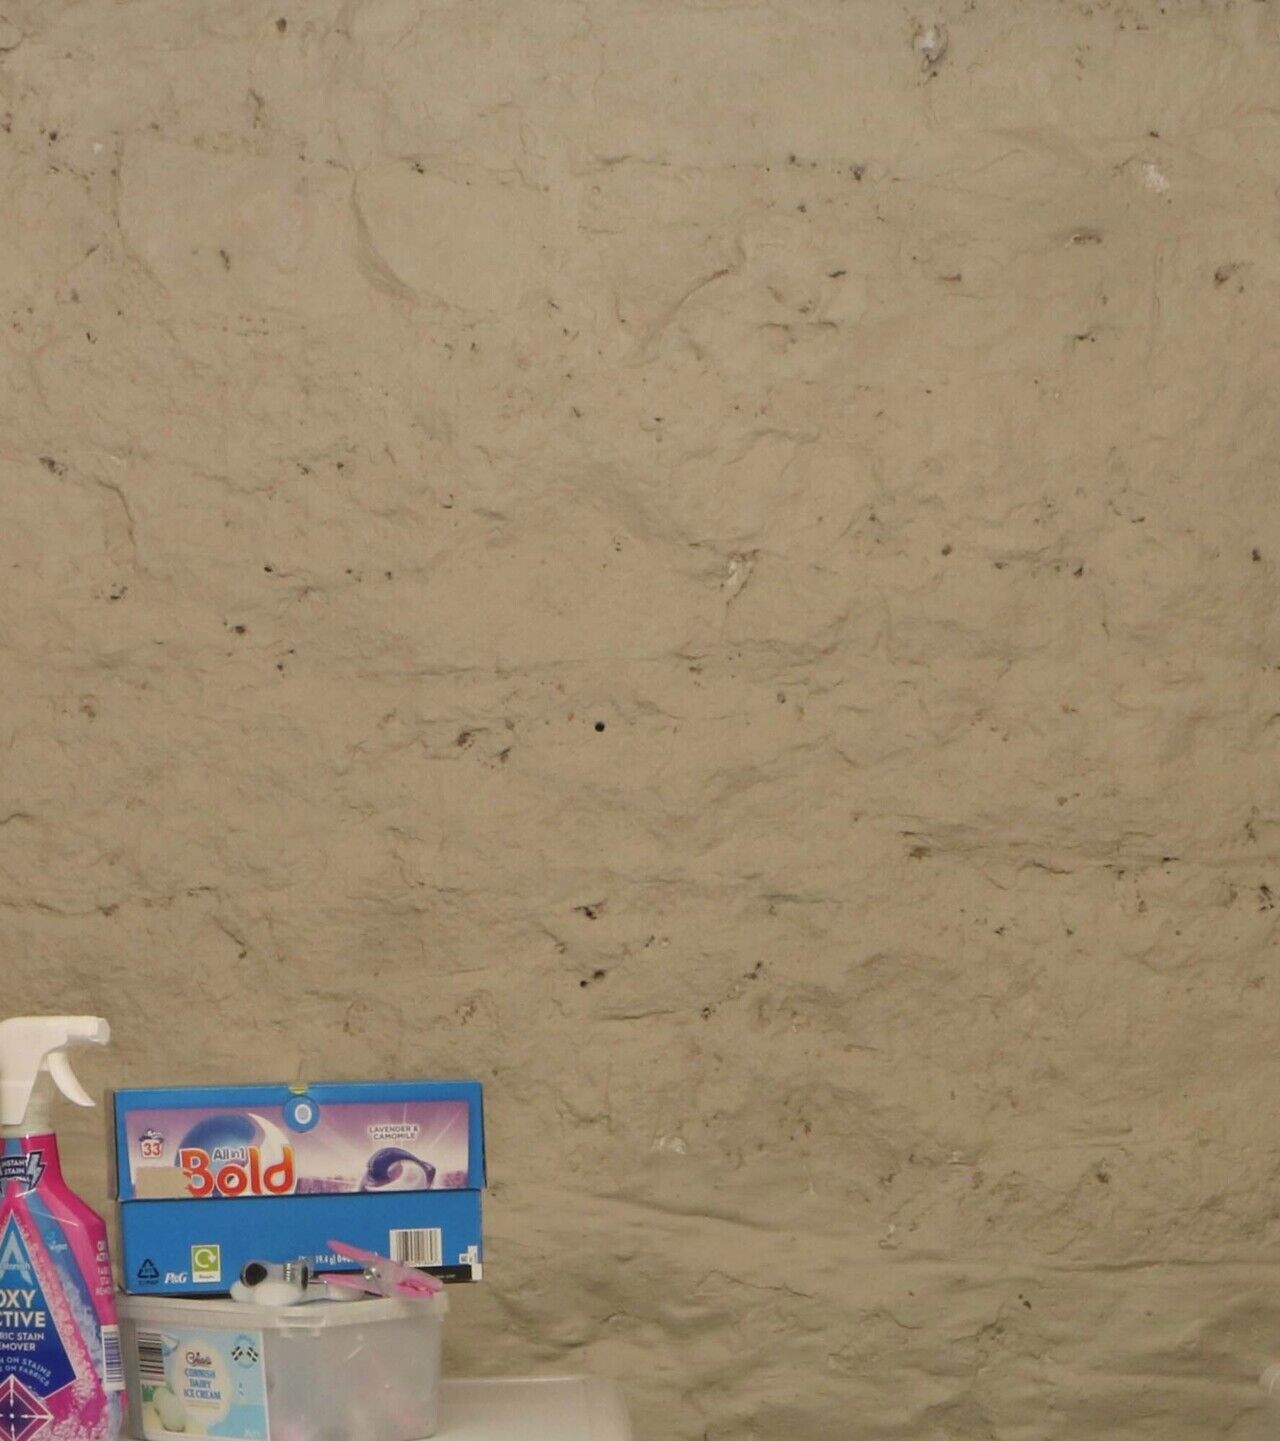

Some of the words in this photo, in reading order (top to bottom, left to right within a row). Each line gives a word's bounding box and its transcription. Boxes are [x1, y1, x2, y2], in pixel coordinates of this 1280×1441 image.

[143, 1142, 161, 1156] 33
[179, 1144, 296, 1197] Bold
[17, 1332, 45, 1341] STAIN
[6, 1356, 20, 1364] ON
[21, 1358, 52, 1377] STAINS
[20, 1365, 50, 1387] FABRICS
[196, 1389, 221, 1400] CREAM
